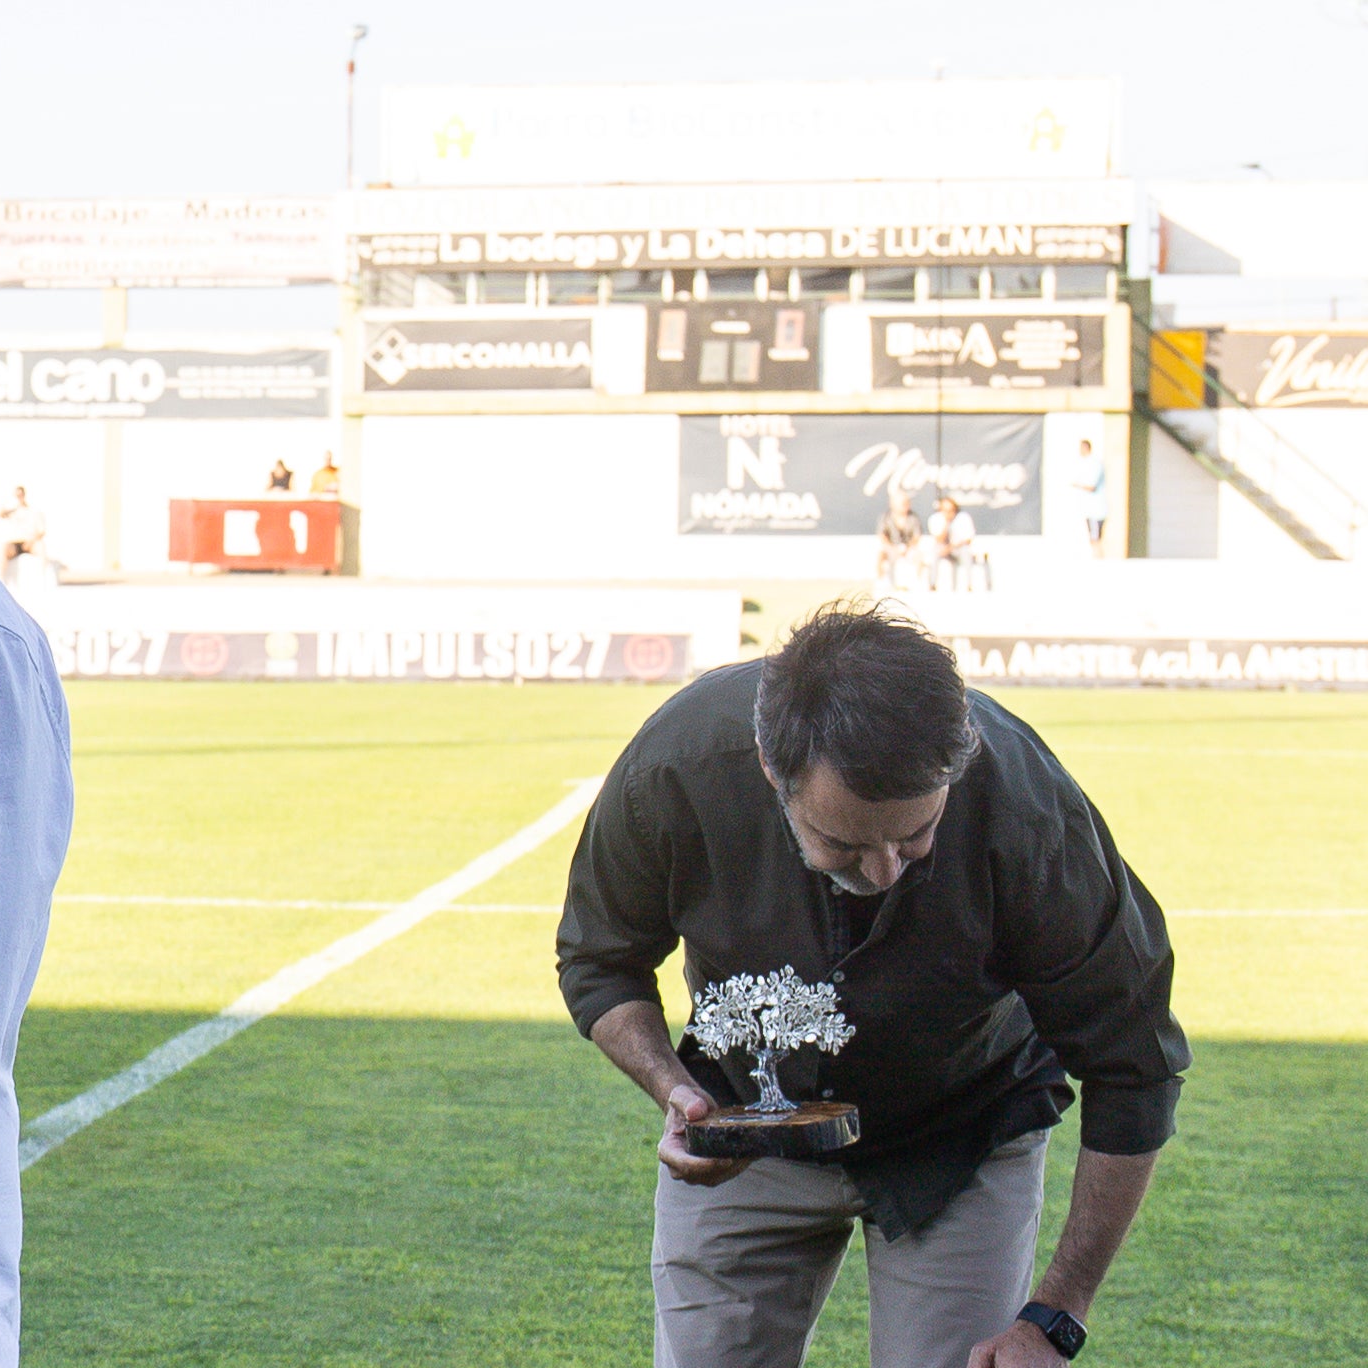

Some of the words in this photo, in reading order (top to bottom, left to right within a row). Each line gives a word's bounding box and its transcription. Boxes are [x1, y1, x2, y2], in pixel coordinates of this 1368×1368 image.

[2, 200, 149, 225] Bricolaje
[182, 199, 328, 221] Maderas
[440, 231, 481, 262] La
[486, 231, 618, 269] bodega
[648, 229, 690, 261] La
[696, 227, 825, 260] Dehesa
[832, 226, 879, 258] DE
[883, 225, 1033, 257] LUCMAN
[31, 357, 165, 403] cano
